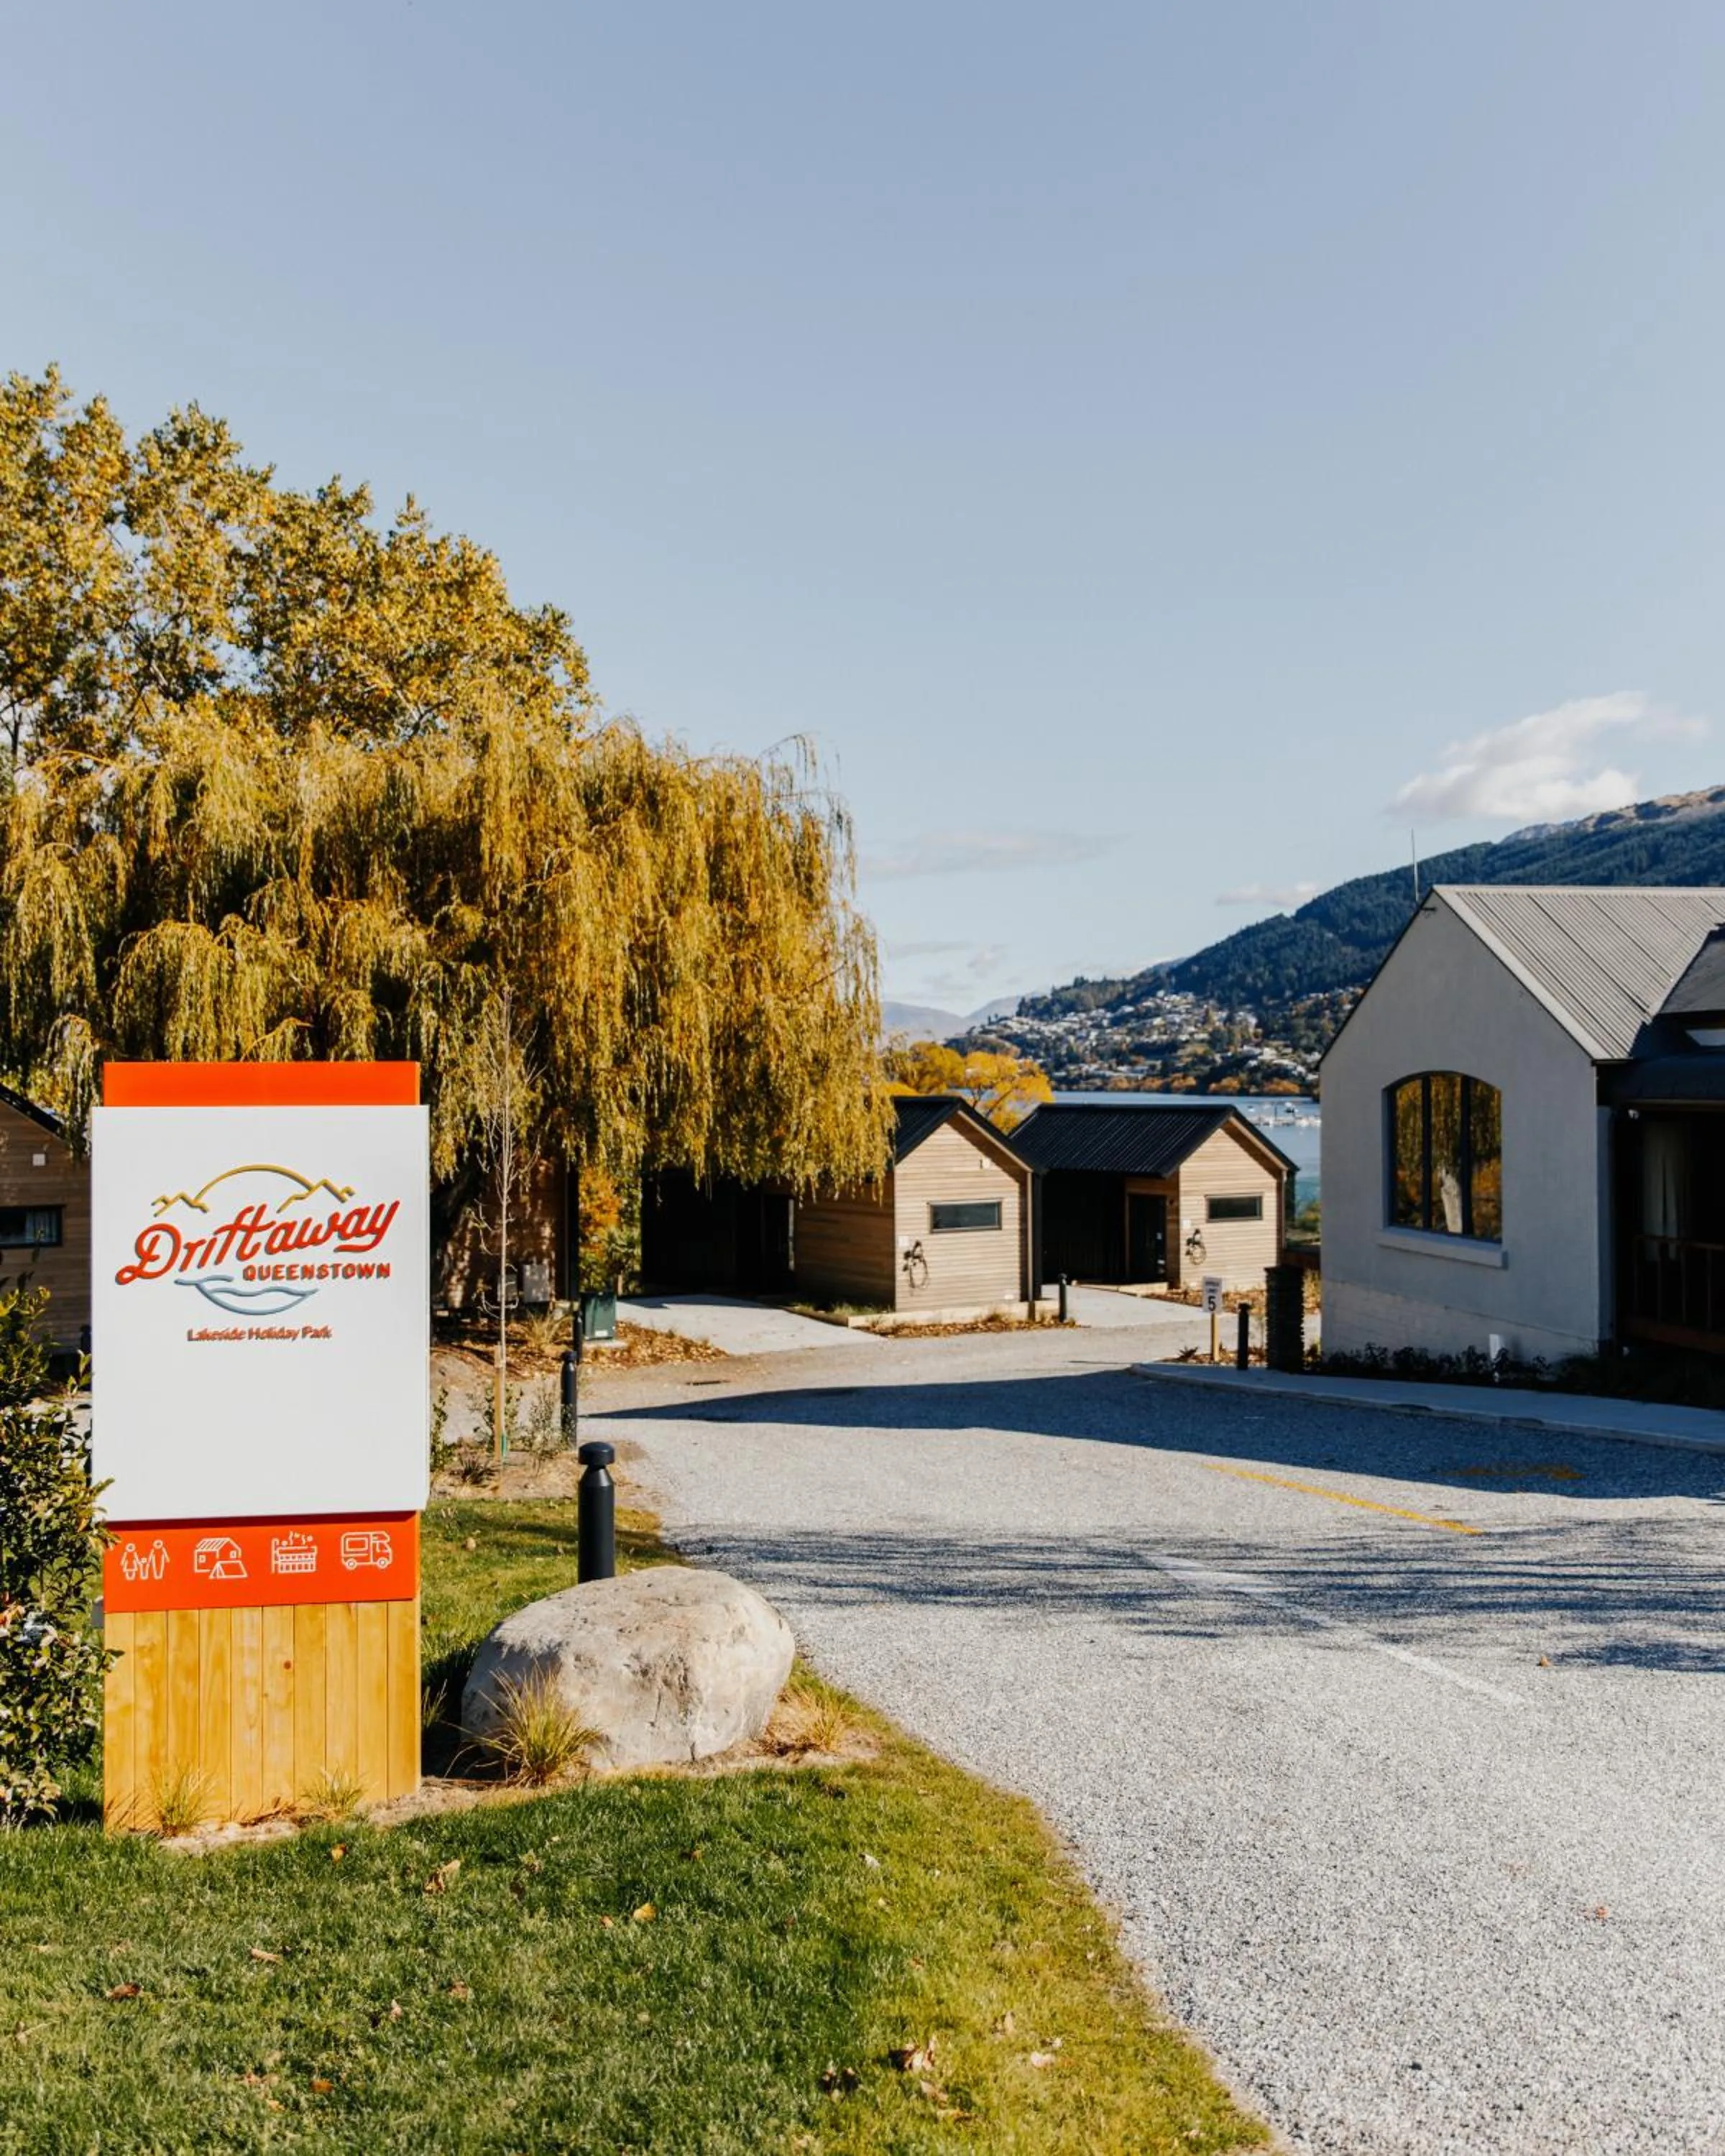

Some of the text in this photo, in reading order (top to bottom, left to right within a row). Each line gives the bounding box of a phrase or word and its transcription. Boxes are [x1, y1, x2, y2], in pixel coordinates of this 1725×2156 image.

[115, 1199, 400, 1285] Driftaway
[242, 1261, 392, 1282] QUEENSTOWN
[1208, 1296, 1216, 1312] 5
[187, 1324, 333, 1342] Lakeside Holiday Park
